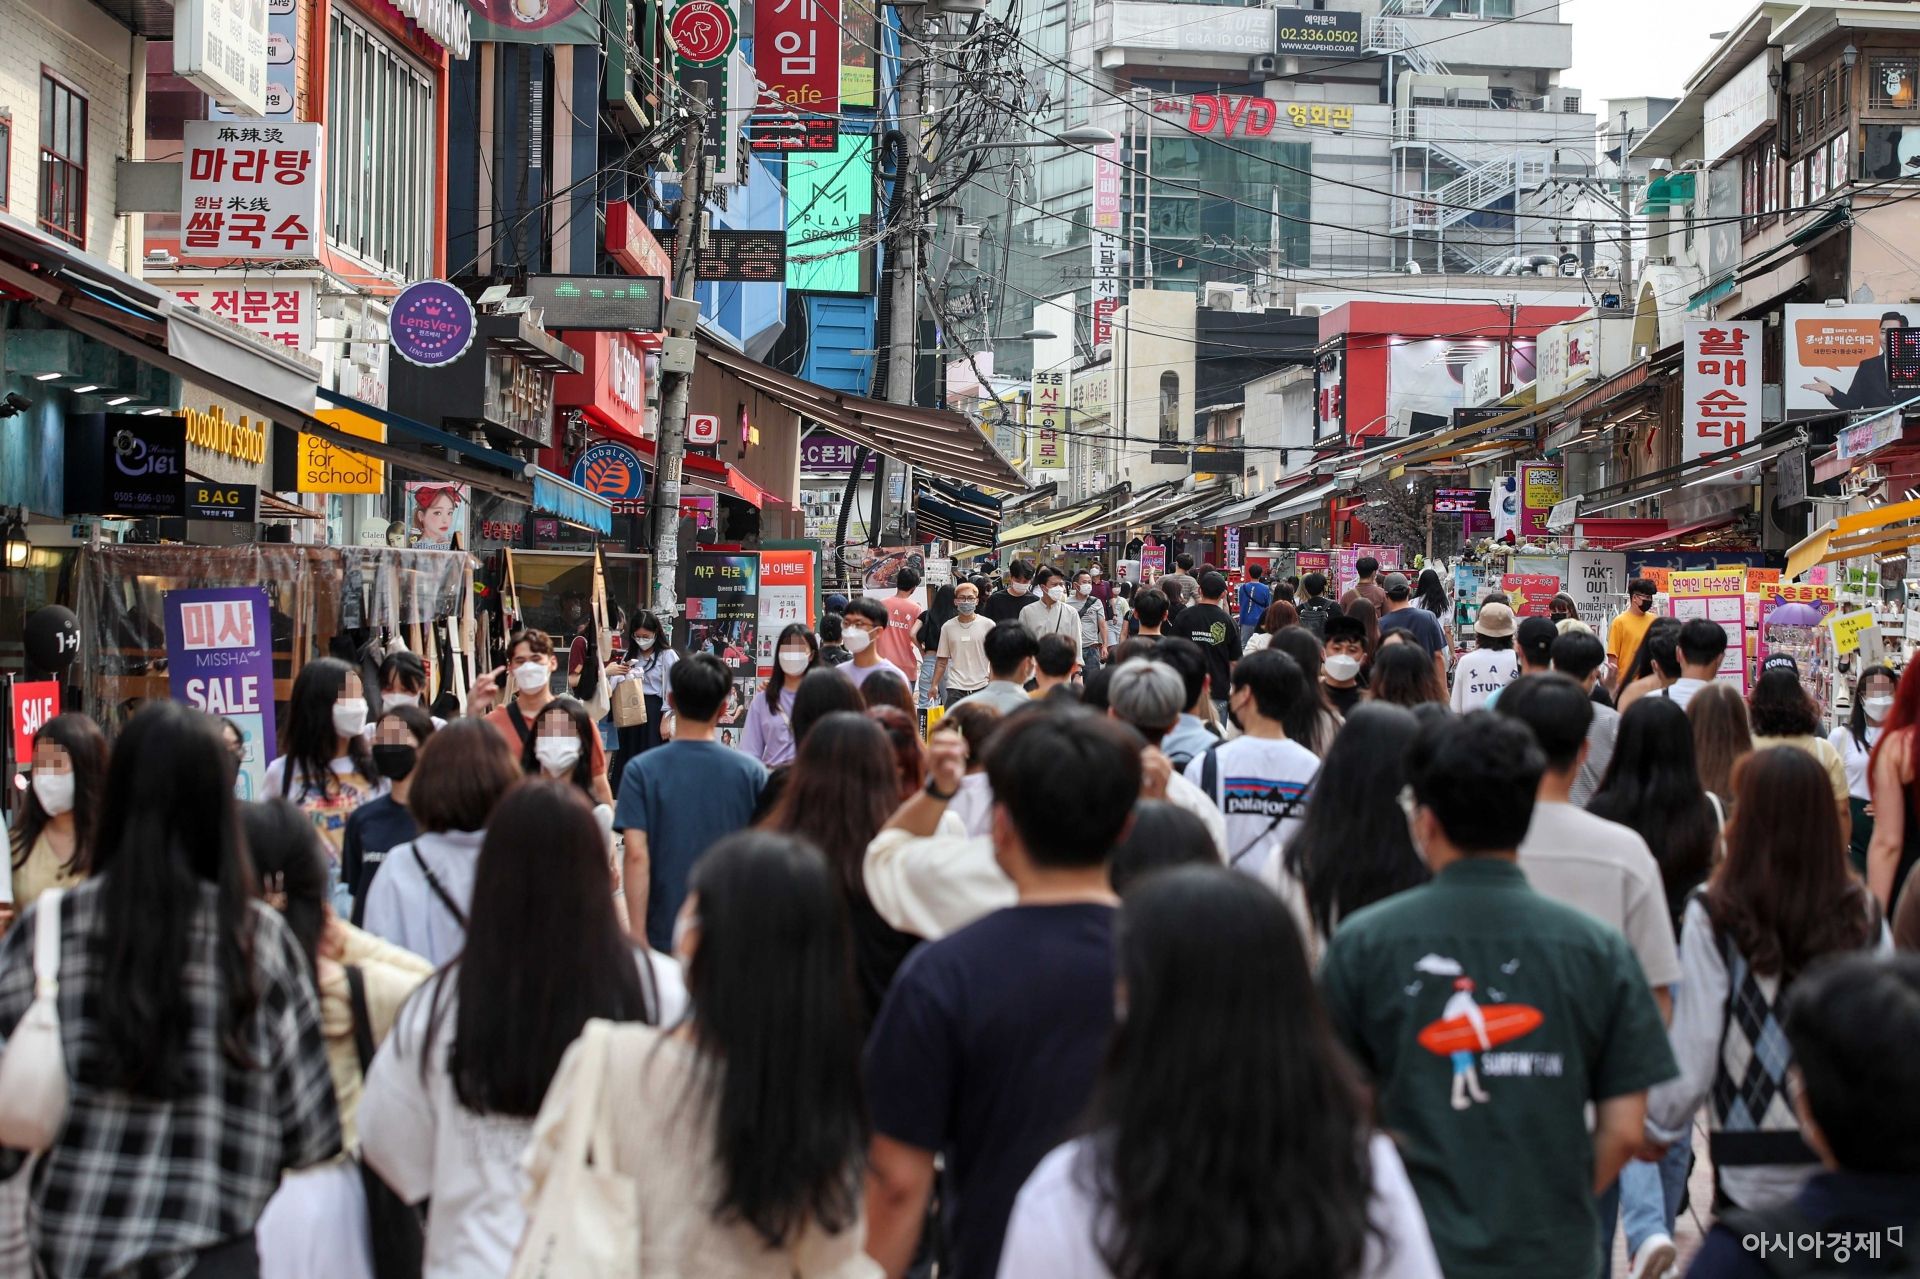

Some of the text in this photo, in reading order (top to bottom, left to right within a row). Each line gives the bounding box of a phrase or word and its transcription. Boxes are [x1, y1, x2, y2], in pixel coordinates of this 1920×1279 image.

[691, 3, 712, 12] RUTA
[1304, 15, 1338, 26] 예약문의
[1236, 34, 1271, 49] OPEN
[1281, 28, 1359, 43] 02.336.0502
[771, 84, 822, 104] Cafe
[1188, 94, 1278, 140] DVD
[1287, 103, 1354, 128] 영화관
[217, 127, 284, 143] 麻辣烫
[190, 148, 311, 185] 마라탕
[227, 196, 271, 212] 米线
[186, 212, 309, 250] 쌀국수
[801, 228, 857, 242] GROUND
[211, 290, 299, 324] 전문점
[400, 313, 462, 337] LensVery
[408, 346, 444, 359] LENS STORE
[199, 410, 219, 450] cool
[220, 408, 234, 456] for
[235, 415, 266, 464] school
[307, 450, 335, 467] for
[583, 448, 634, 468] global eco
[799, 444, 877, 464] &C폰케스
[307, 466, 374, 485] school
[198, 489, 239, 505] BAG
[694, 564, 741, 579] 사주 타로
[773, 563, 805, 575] 이벤트
[1672, 577, 1701, 593] 연예인
[1703, 576, 1741, 592] 다수상담
[1766, 584, 1829, 601] 방송출연
[778, 607, 797, 619] 1:1
[183, 602, 254, 647] 미샤
[56, 629, 81, 654] 1+1
[196, 652, 249, 667] MISSHA
[1765, 657, 1793, 668] KOREA
[186, 676, 260, 714] SALE
[1470, 683, 1506, 693] STUD
[22, 697, 53, 736] SALE
[1229, 796, 1305, 816] patagoa
